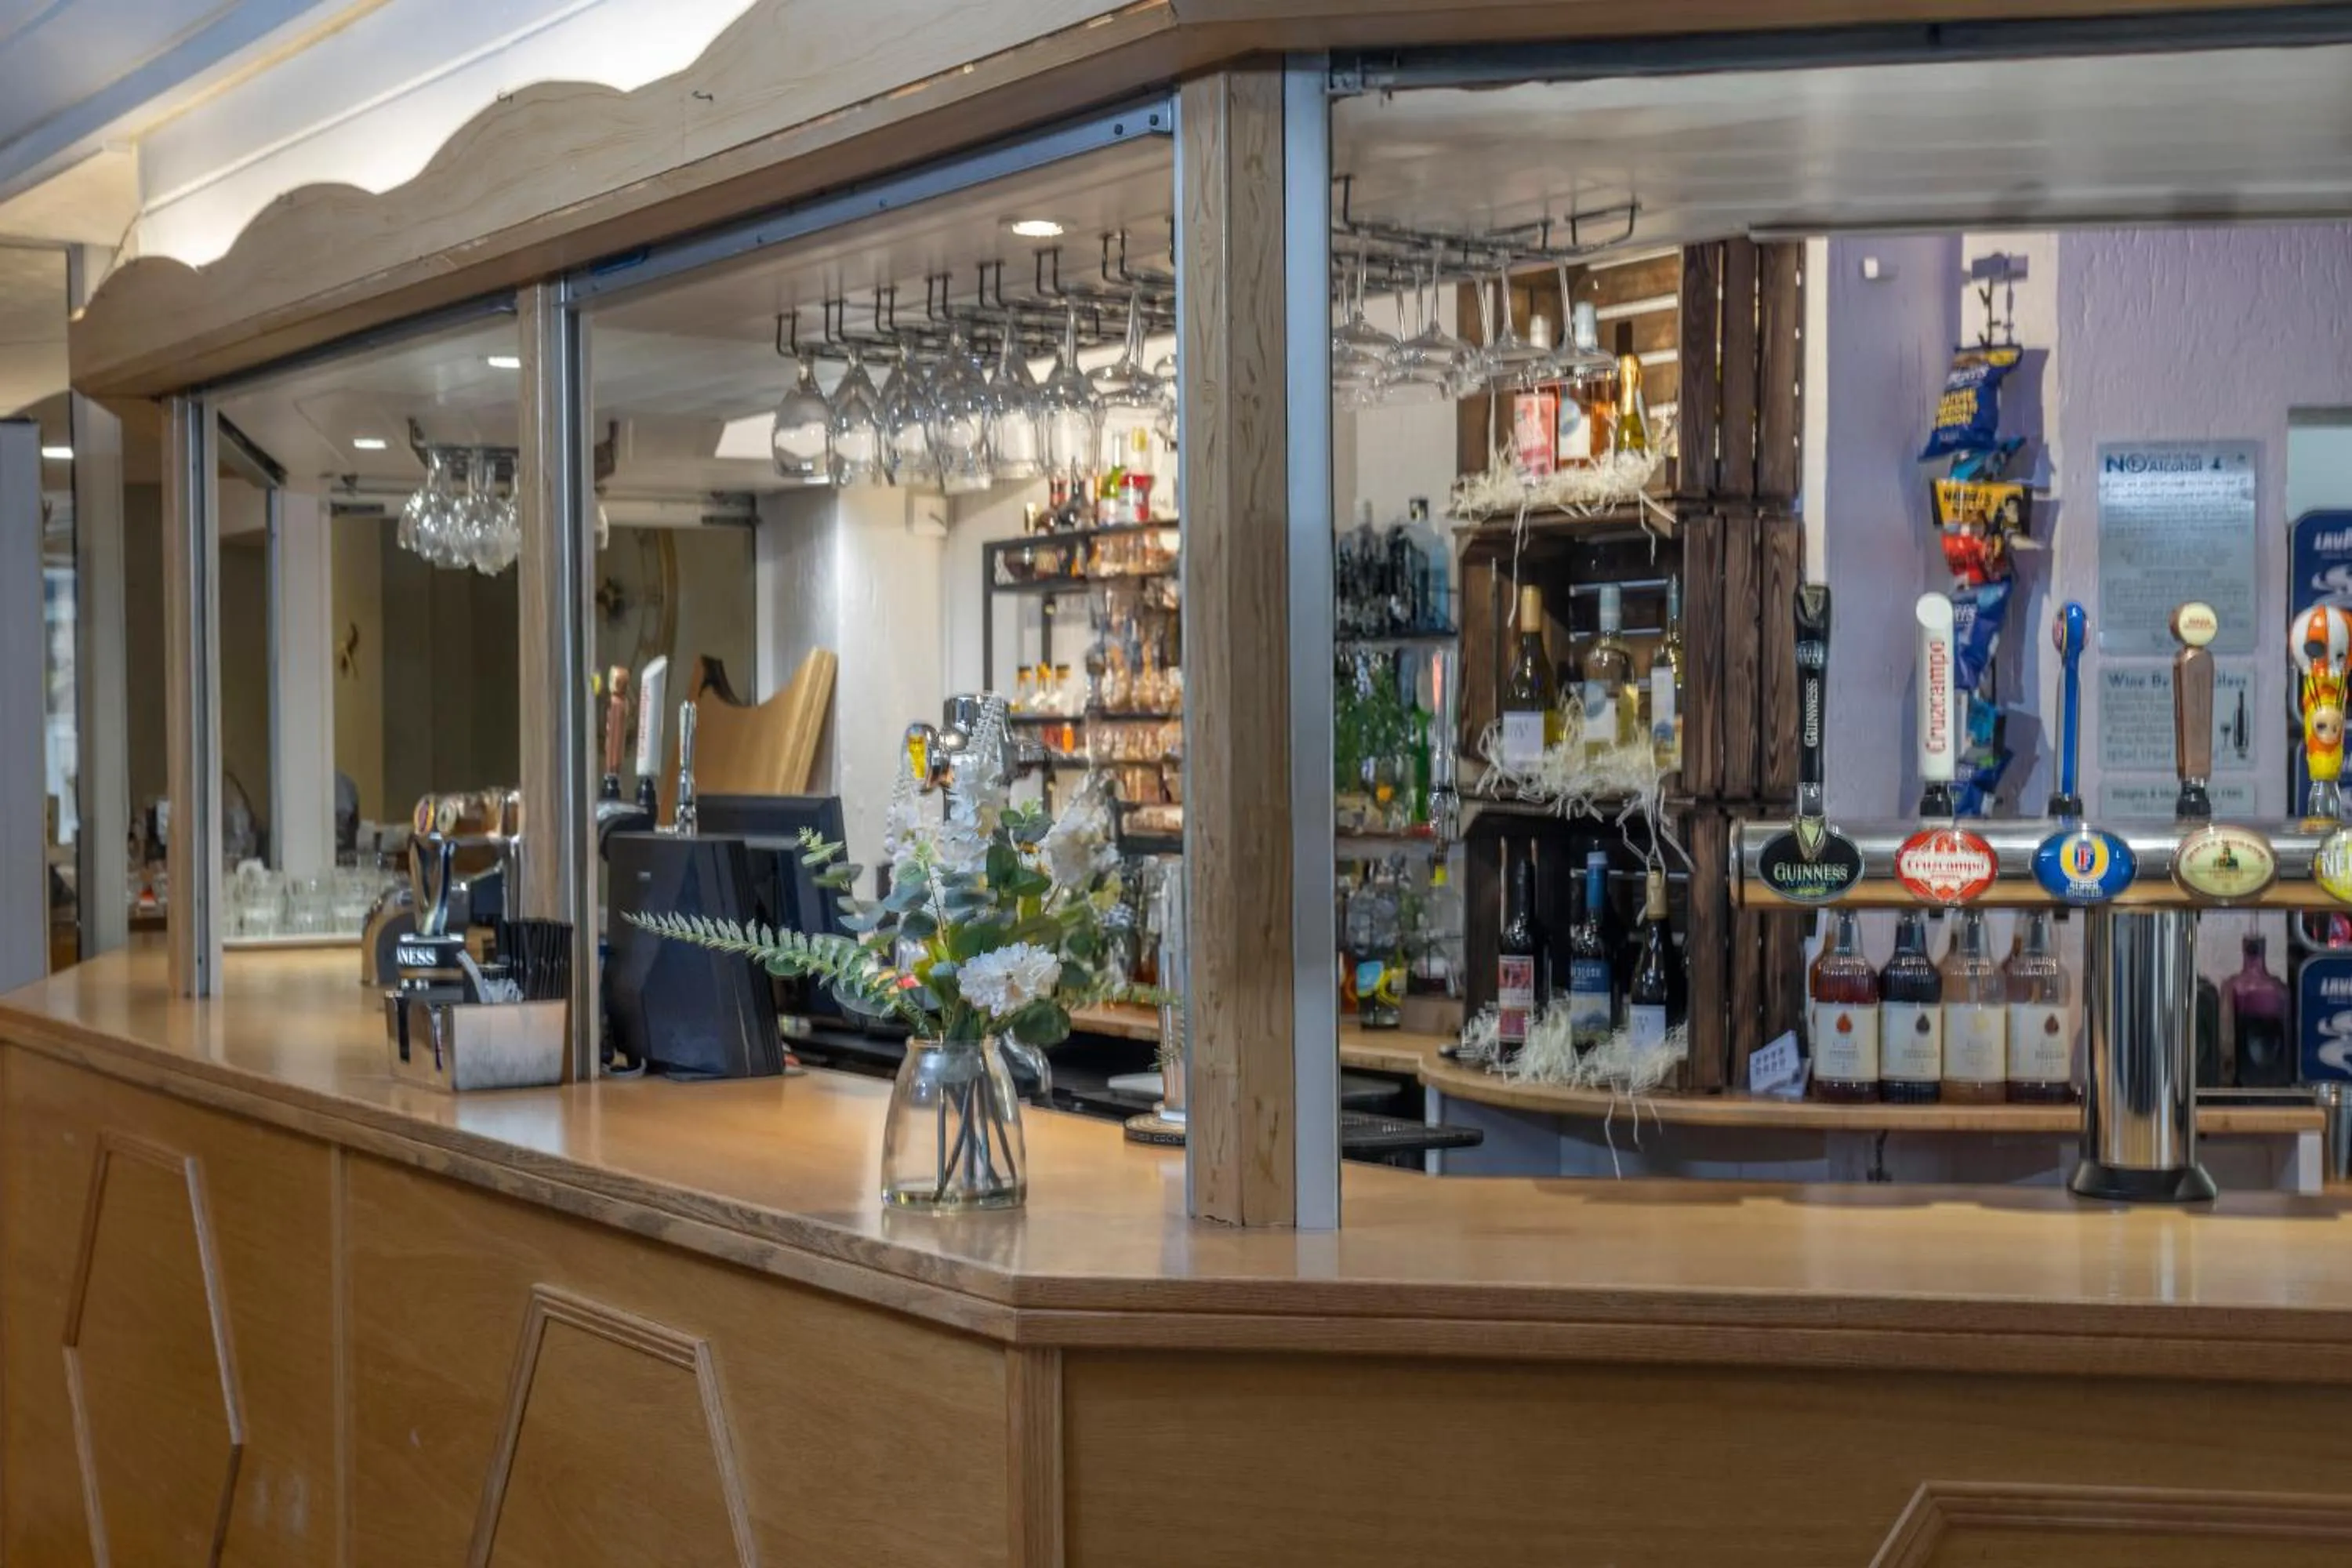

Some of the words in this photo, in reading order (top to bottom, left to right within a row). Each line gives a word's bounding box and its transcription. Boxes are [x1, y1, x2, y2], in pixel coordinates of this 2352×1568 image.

[2147, 459, 2202, 472] Alcohol
[2108, 673, 2146, 688] Wine
[1926, 639, 1949, 754] Cruzcampo
[1804, 677, 1818, 747] GUINNESS
[1773, 862, 1849, 881] GUINNESS
